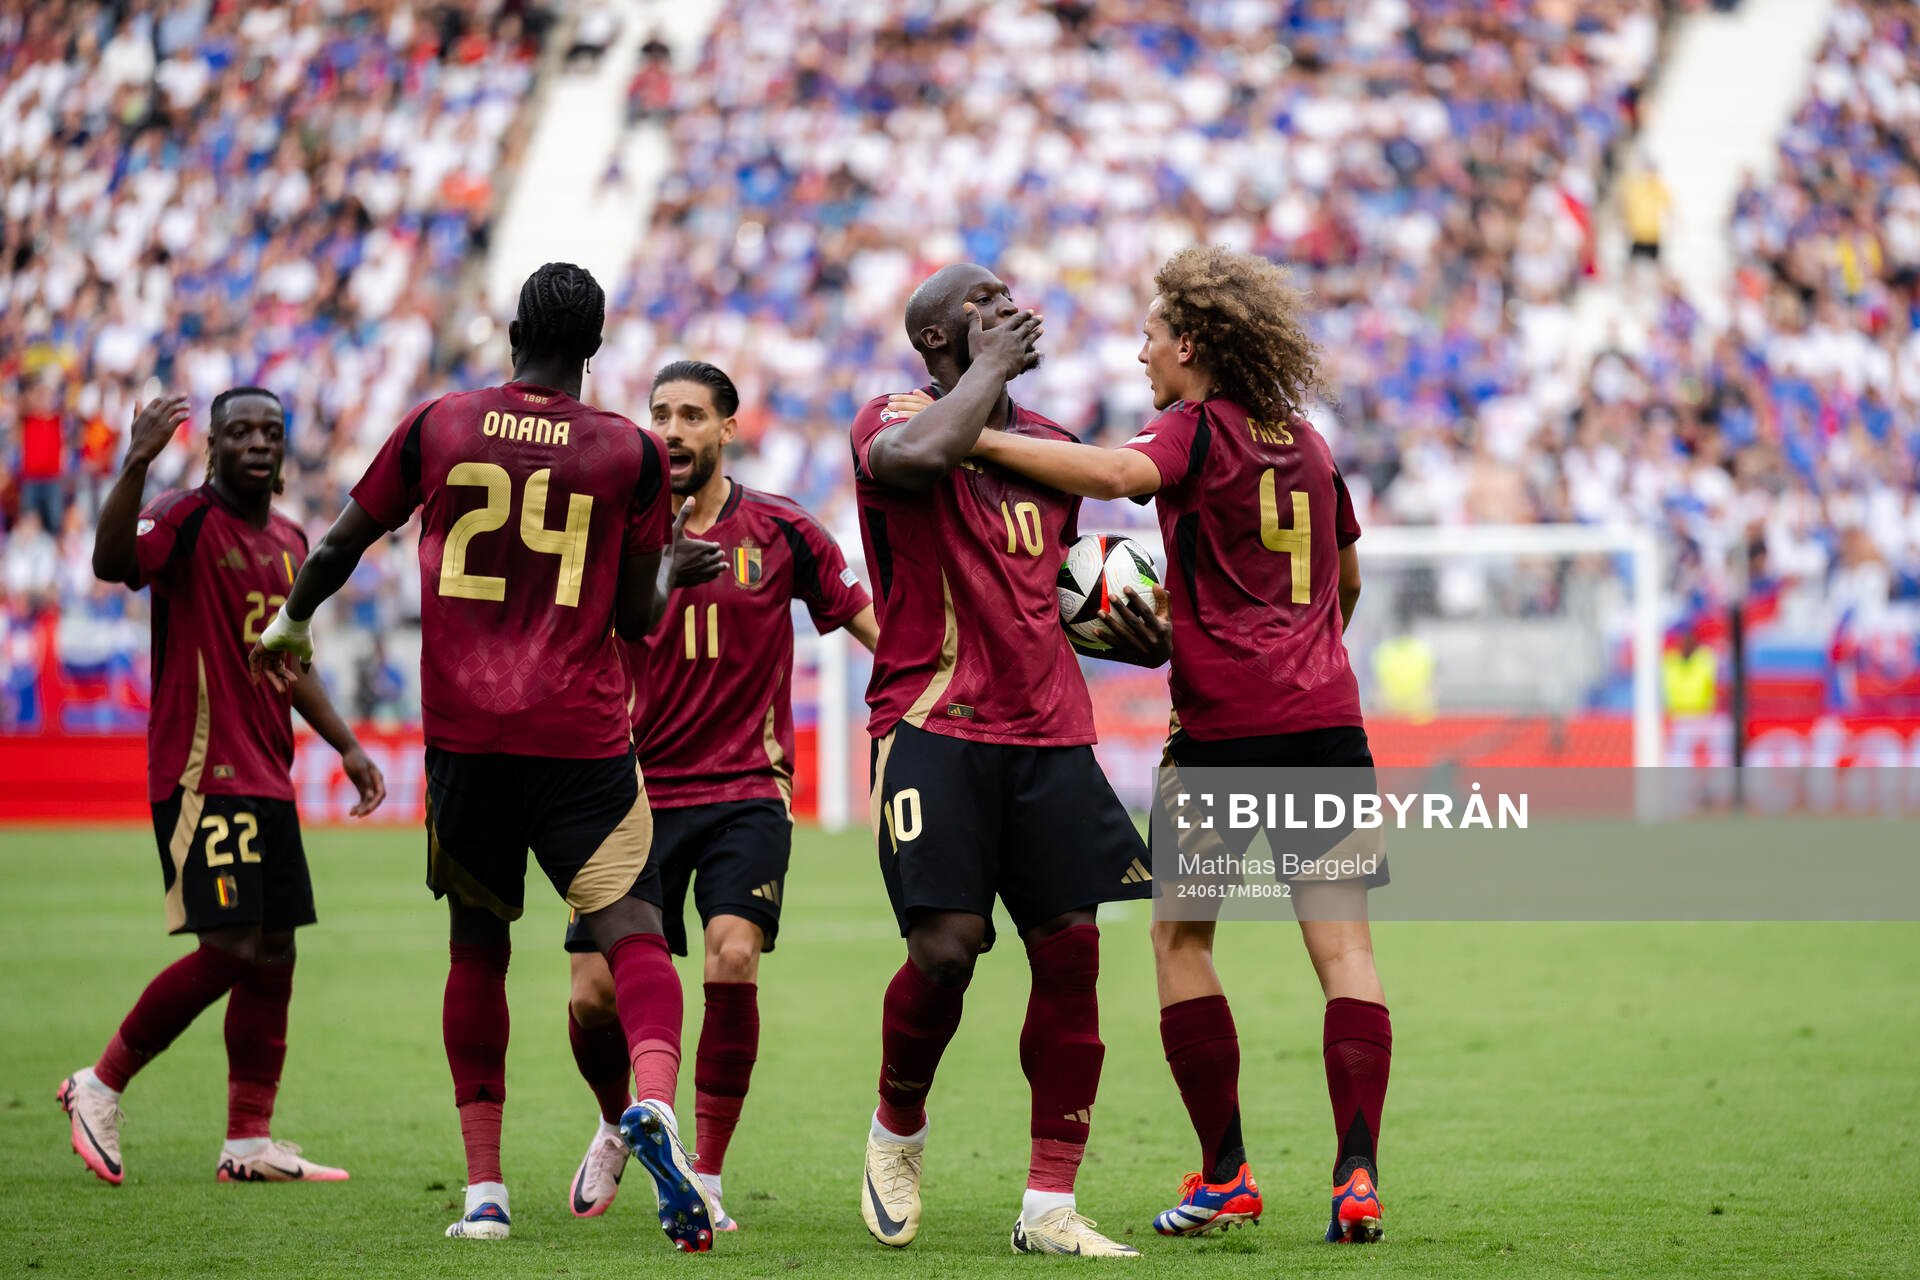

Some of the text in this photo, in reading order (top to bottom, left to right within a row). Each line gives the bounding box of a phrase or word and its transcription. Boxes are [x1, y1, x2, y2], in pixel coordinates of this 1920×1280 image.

[523, 394, 549, 405] 1895
[483, 411, 570, 445] ONANA
[438, 462, 594, 608] 24
[1001, 501, 1044, 557] 10
[1259, 468, 1311, 605] 4
[684, 603, 719, 660] 11
[201, 812, 262, 868] 22
[884, 788, 922, 855] 10
